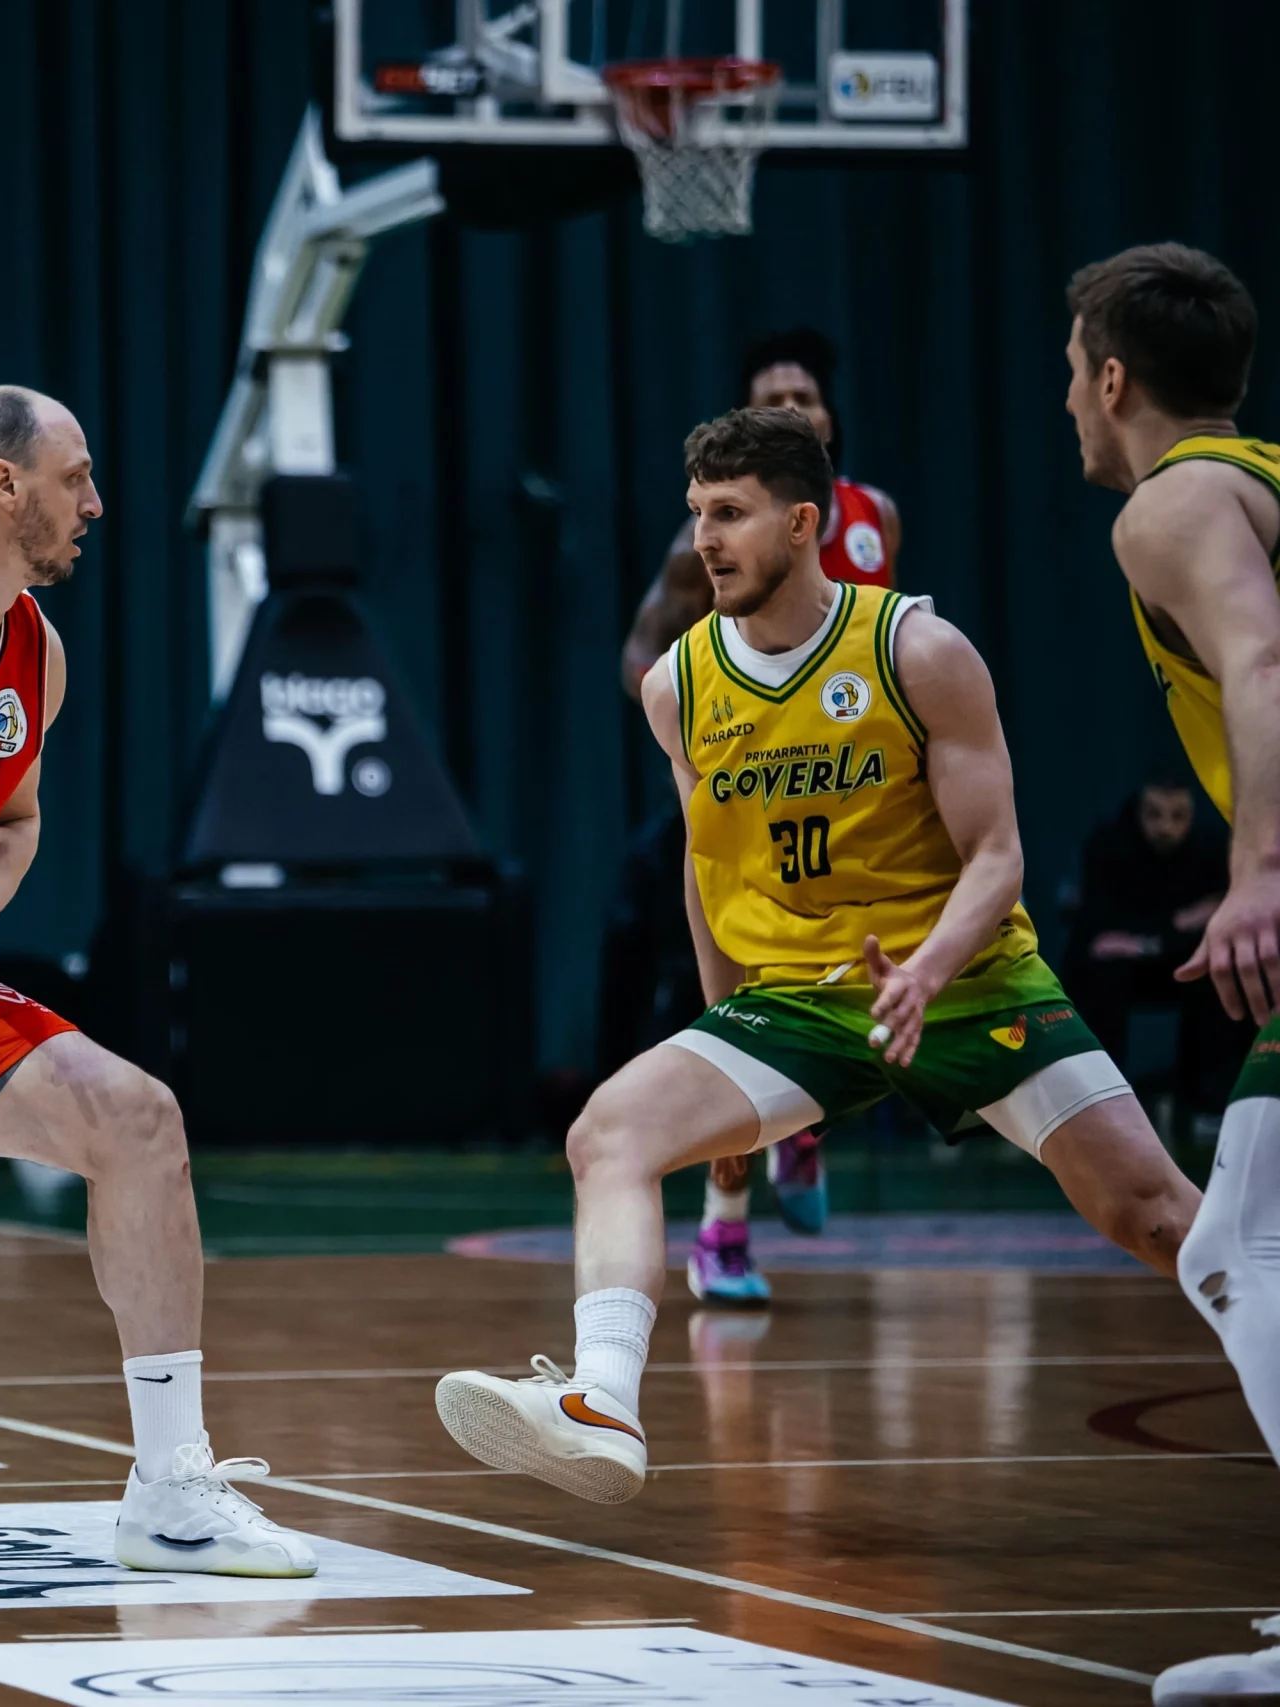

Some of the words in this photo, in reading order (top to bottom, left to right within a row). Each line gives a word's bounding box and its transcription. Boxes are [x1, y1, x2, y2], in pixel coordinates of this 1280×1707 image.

[702, 722, 755, 747] HARAZD
[744, 743, 831, 763] PRYKARPATTIA
[709, 741, 887, 811] GOVERLA
[768, 815, 832, 884] 30
